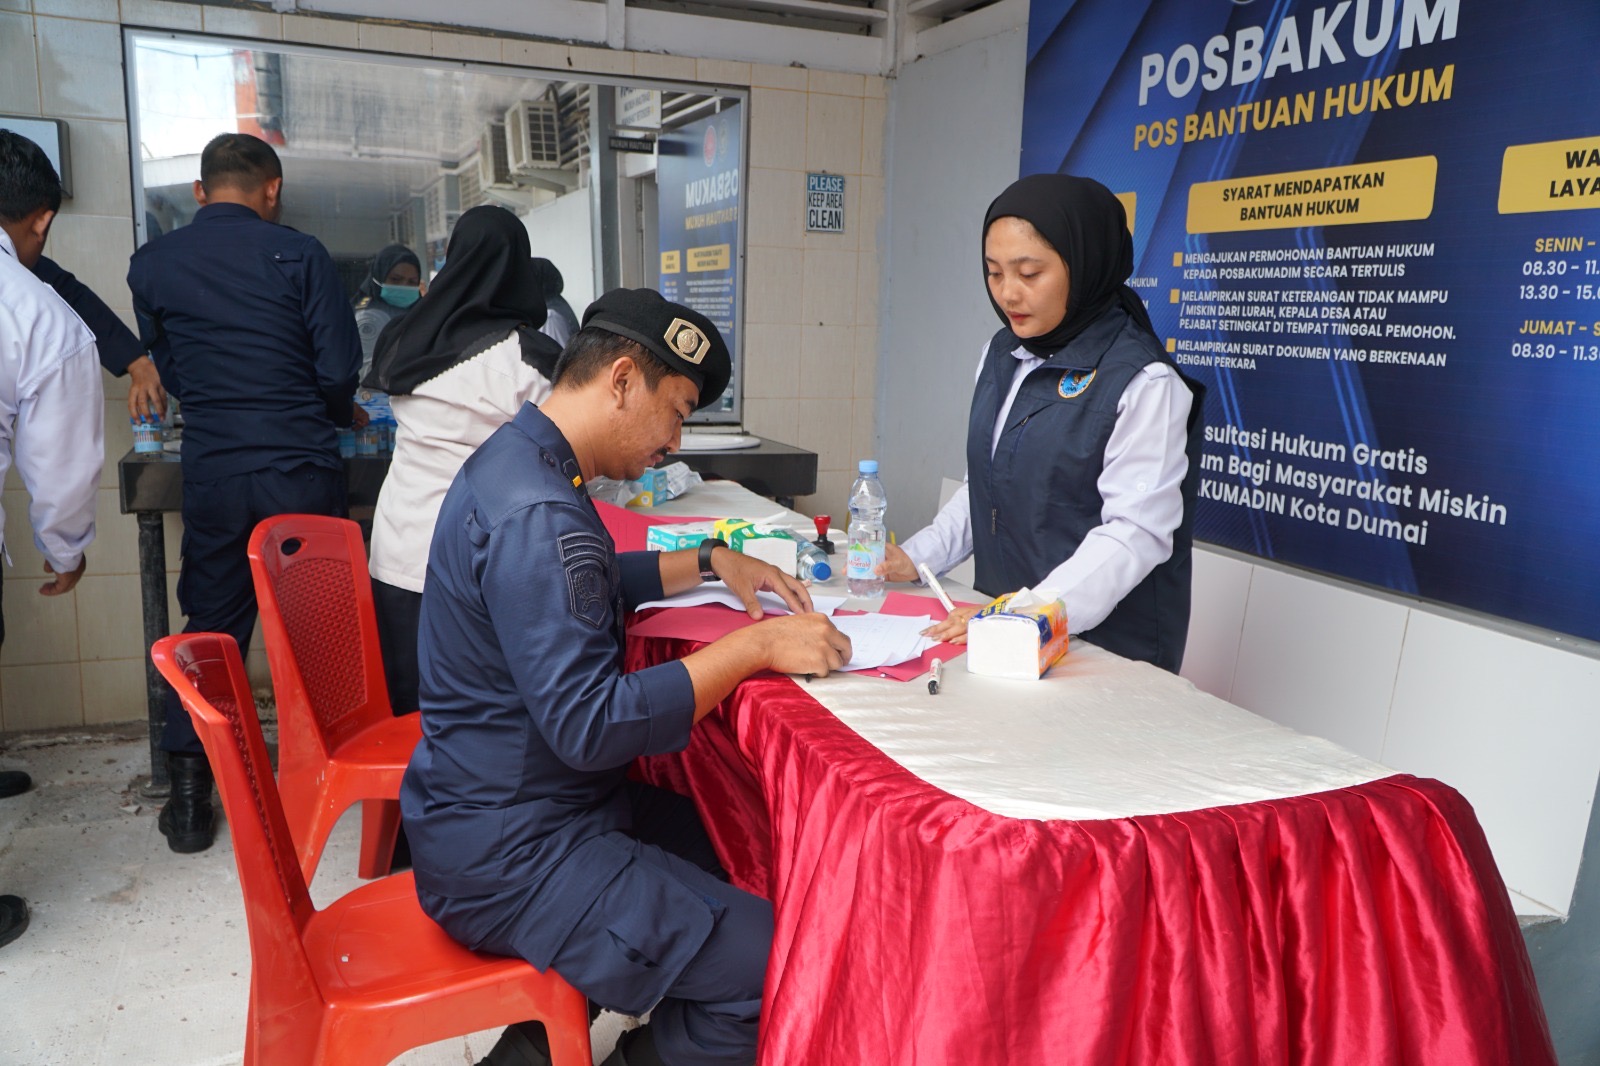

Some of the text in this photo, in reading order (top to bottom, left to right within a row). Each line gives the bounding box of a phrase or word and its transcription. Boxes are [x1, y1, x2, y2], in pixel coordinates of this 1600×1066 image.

[1139, 0, 1460, 106] POSBAKUM
[1134, 64, 1455, 151] POS BANTUAN HUKUM
[1565, 149, 1600, 169] WA
[809, 177, 843, 192] PLEASE
[1222, 172, 1385, 202] SYARAT MENDAPATKAN
[808, 193, 842, 209] KEEP AREA
[1240, 198, 1359, 221] BANTUAN HUKUM
[809, 209, 841, 229] CLEAN
[1185, 243, 1435, 264] MENGAJUKAN PERMOHONAN BANTUAN HUKUM
[1535, 237, 1583, 253] SENIN
[1184, 264, 1405, 280] KEPADA POSBAKUMADIM SECARA TERTULIS
[1522, 261, 1567, 275] 08.30
[1132, 278, 1158, 287] HUKUM
[1182, 290, 1448, 303] MELAMPIRKAN SURAT KETERANGAN TIDAK MAMPU
[1520, 285, 1558, 300] 13.30
[1180, 302, 1387, 320] / MISKIN DARI LURAH, KEPALA DESA ATAU
[1179, 319, 1456, 339] PEJABAT SETINGKAT DI TEMPAT TINGGAL PEMOHON.
[1519, 320, 1576, 335] JUMAT
[1178, 340, 1447, 367] MELAMPIRKAN SURAT DOKUMEN YANG BERKENAAN
[1511, 343, 1555, 359] 08.30
[1573, 346, 1600, 361] 11.3
[1176, 354, 1256, 370] DENGAN PERKARA
[1204, 425, 1428, 475] sultasi Hukum Gratis
[1228, 455, 1271, 486] Bagi
[1275, 463, 1413, 507] Masyarakat
[1419, 488, 1507, 525] Miskin
[1198, 479, 1429, 545] KUMADIN Kota Dumai
